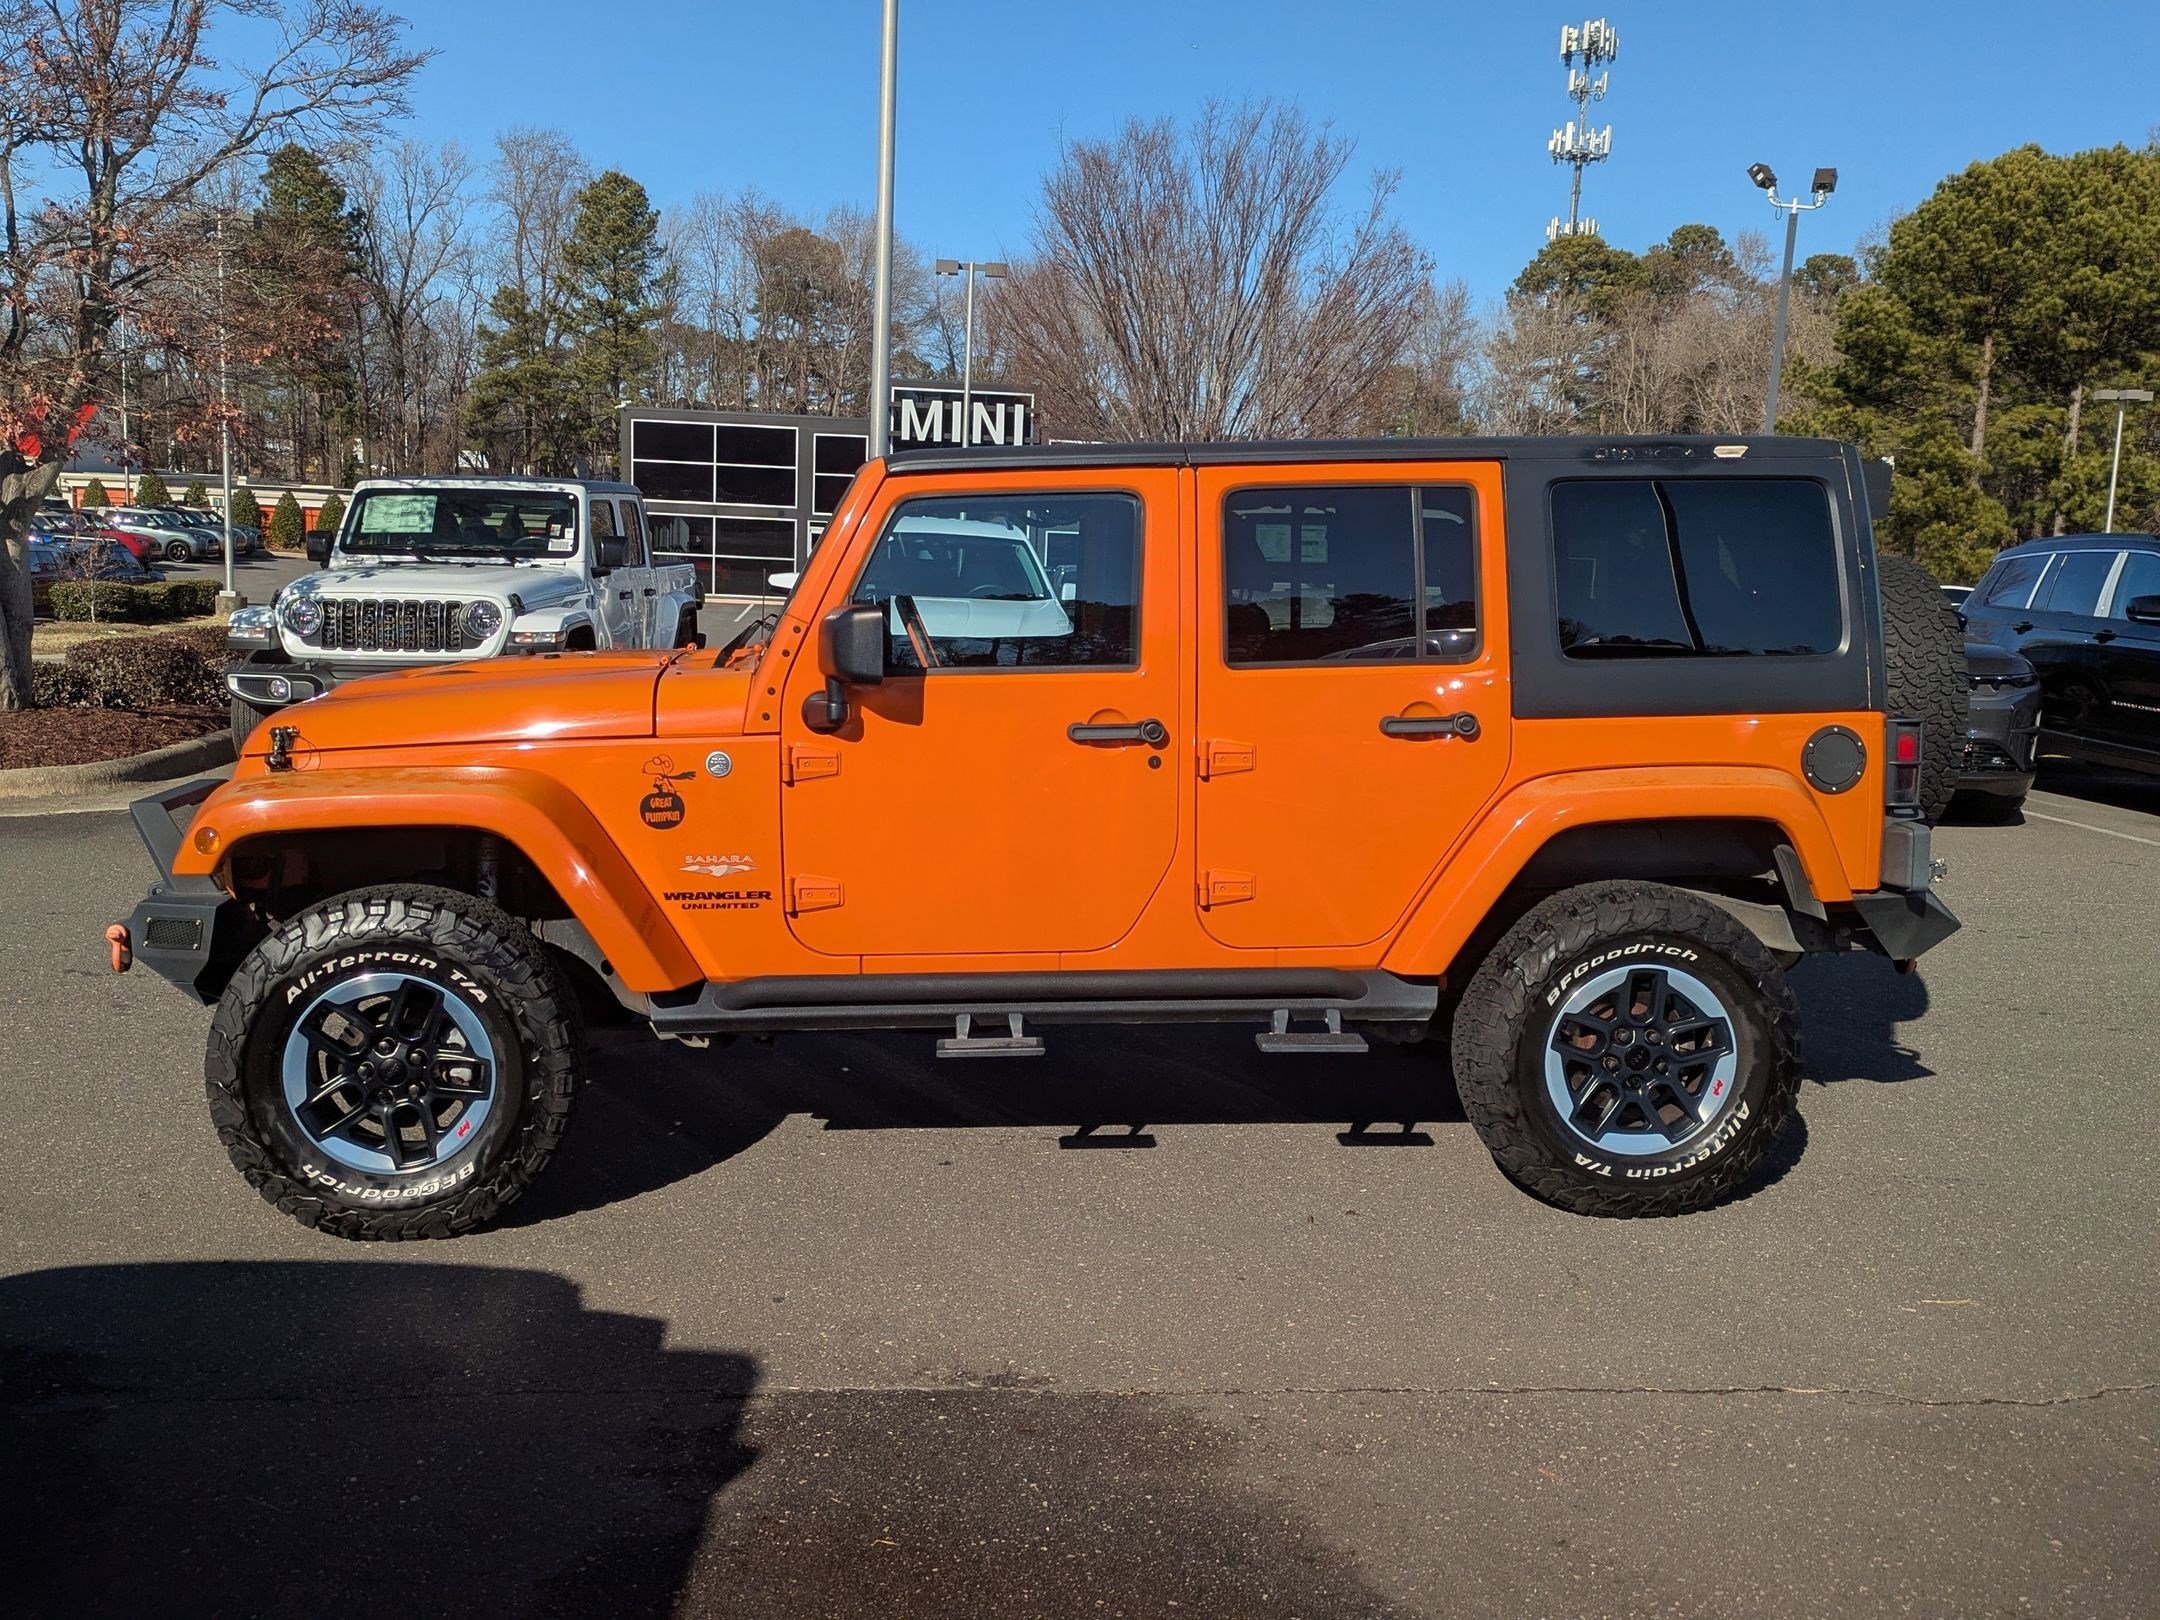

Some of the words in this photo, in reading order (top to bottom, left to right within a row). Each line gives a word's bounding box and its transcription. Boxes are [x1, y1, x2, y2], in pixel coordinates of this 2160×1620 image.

[901, 399, 1024, 446] MINI
[650, 797, 672, 808] GREAT
[685, 855, 753, 864] SAHARA
[664, 891, 772, 900] WRANGLER
[286, 951, 438, 1004] All-Terrain
[450, 969, 488, 1004] T/A
[1546, 943, 1698, 1006] BFGoodrich
[1626, 1100, 1750, 1180] All-Terrain
[302, 1161, 475, 1200] BFGoodrich
[1574, 1152, 1612, 1177] T/A
